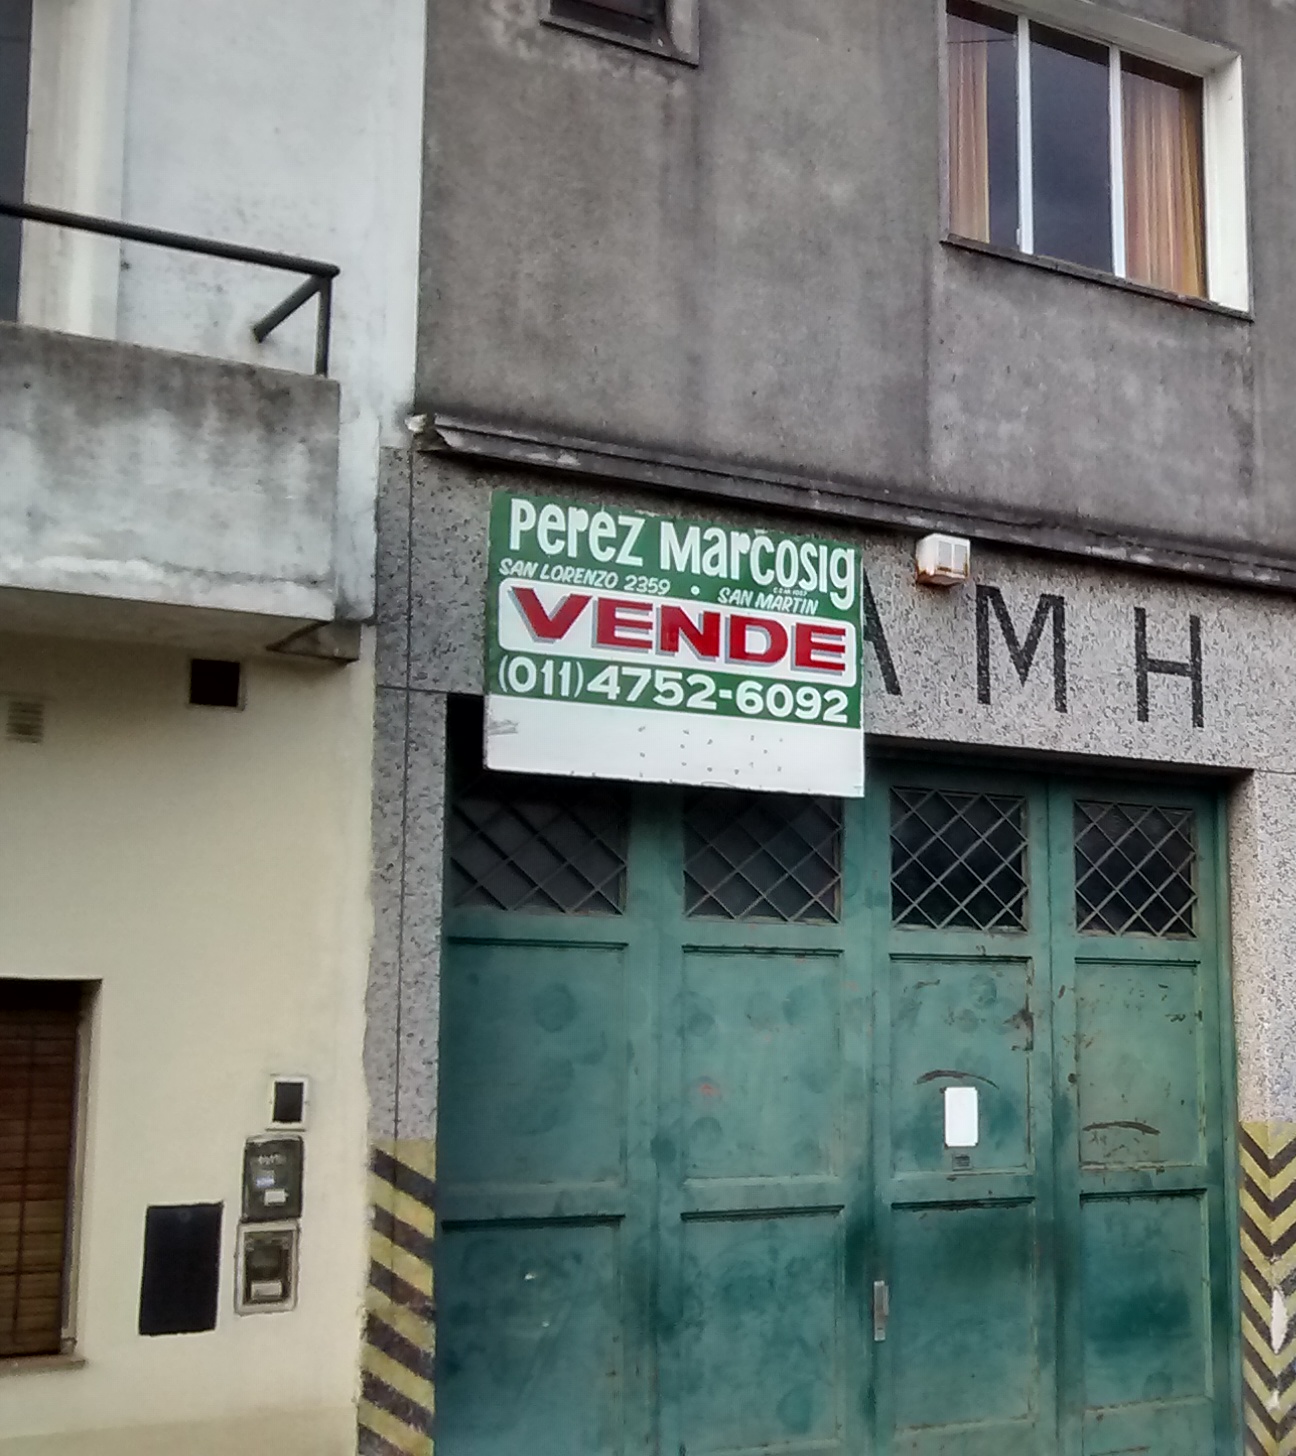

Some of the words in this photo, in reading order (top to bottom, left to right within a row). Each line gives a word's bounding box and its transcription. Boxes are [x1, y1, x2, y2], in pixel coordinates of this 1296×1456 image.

[499, 557, 536, 578] SAN
[540, 563, 619, 590] LORENZO
[624, 574, 671, 596] 2359
[717, 586, 754, 608] SAN
[755, 592, 819, 615] MARTIN
[509, 497, 647, 567] Perez
[659, 521, 855, 611] Marcosig
[508, 586, 847, 676] VENDE
